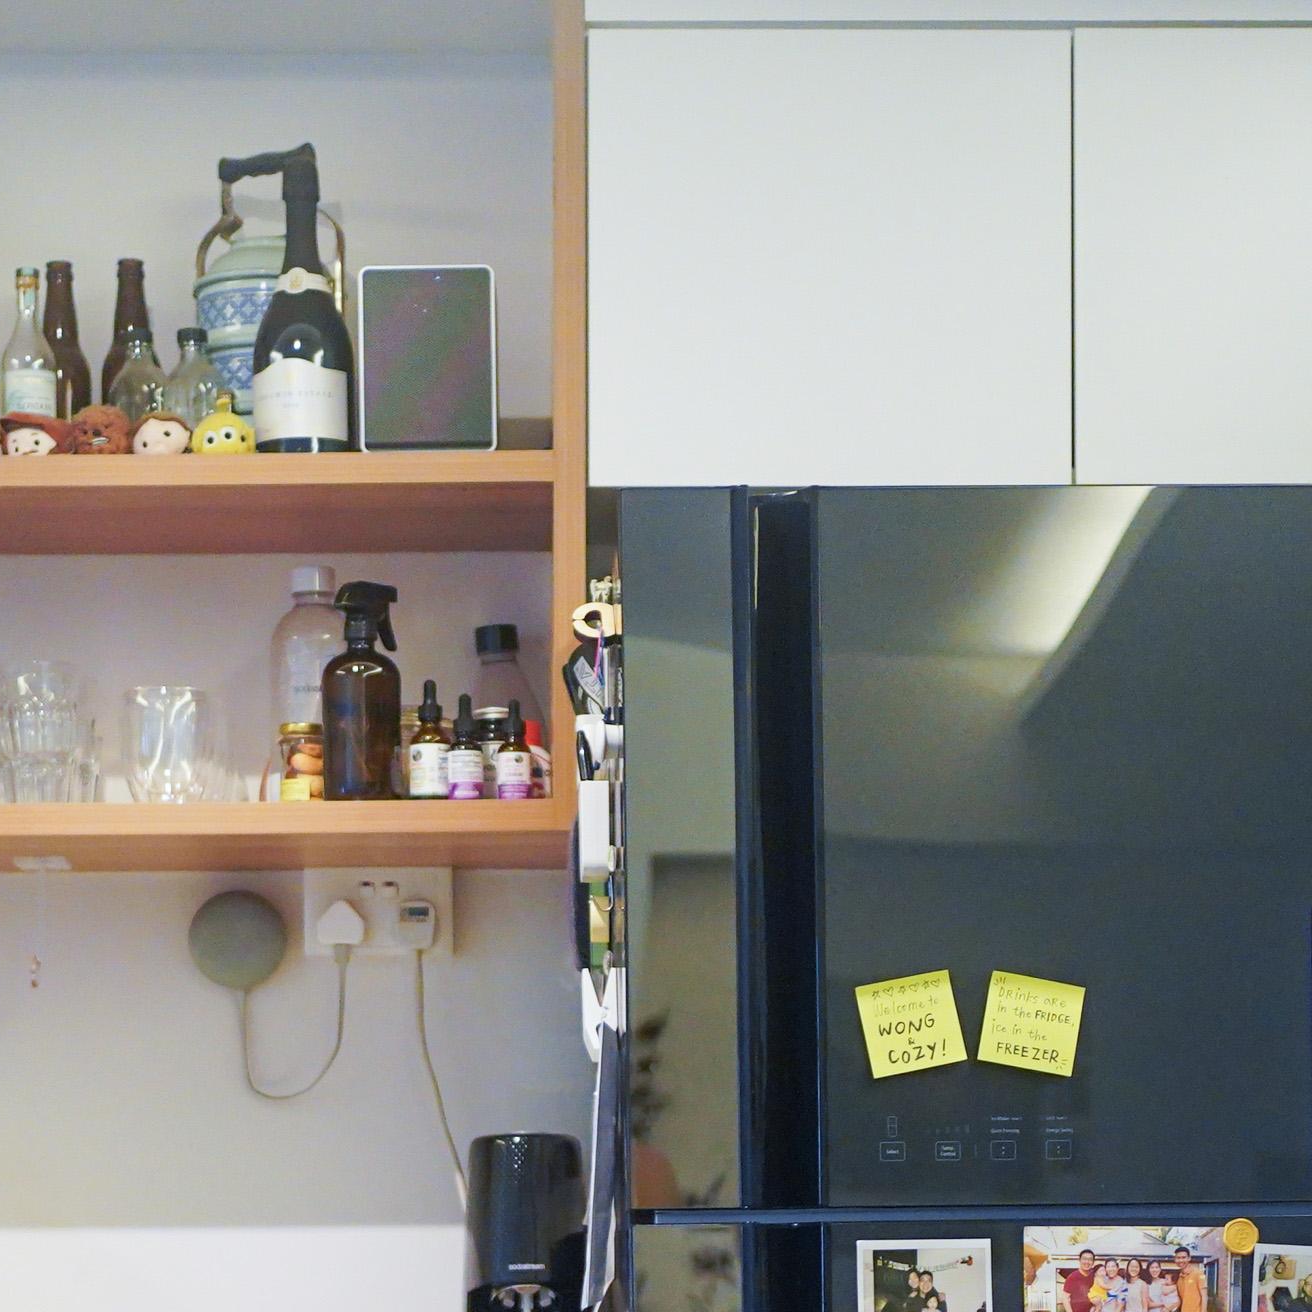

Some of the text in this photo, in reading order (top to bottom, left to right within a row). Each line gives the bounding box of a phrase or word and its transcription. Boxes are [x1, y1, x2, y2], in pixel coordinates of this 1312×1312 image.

[874, 1001, 925, 1018] Welcome
[997, 1001, 1007, 1013] in
[1013, 1007, 1031, 1019] the
[878, 1013, 935, 1037] WONG
[991, 1018, 1048, 1041] ice in the
[888, 1038, 946, 1064] COZY!
[996, 1042, 1059, 1063] FREEZER
